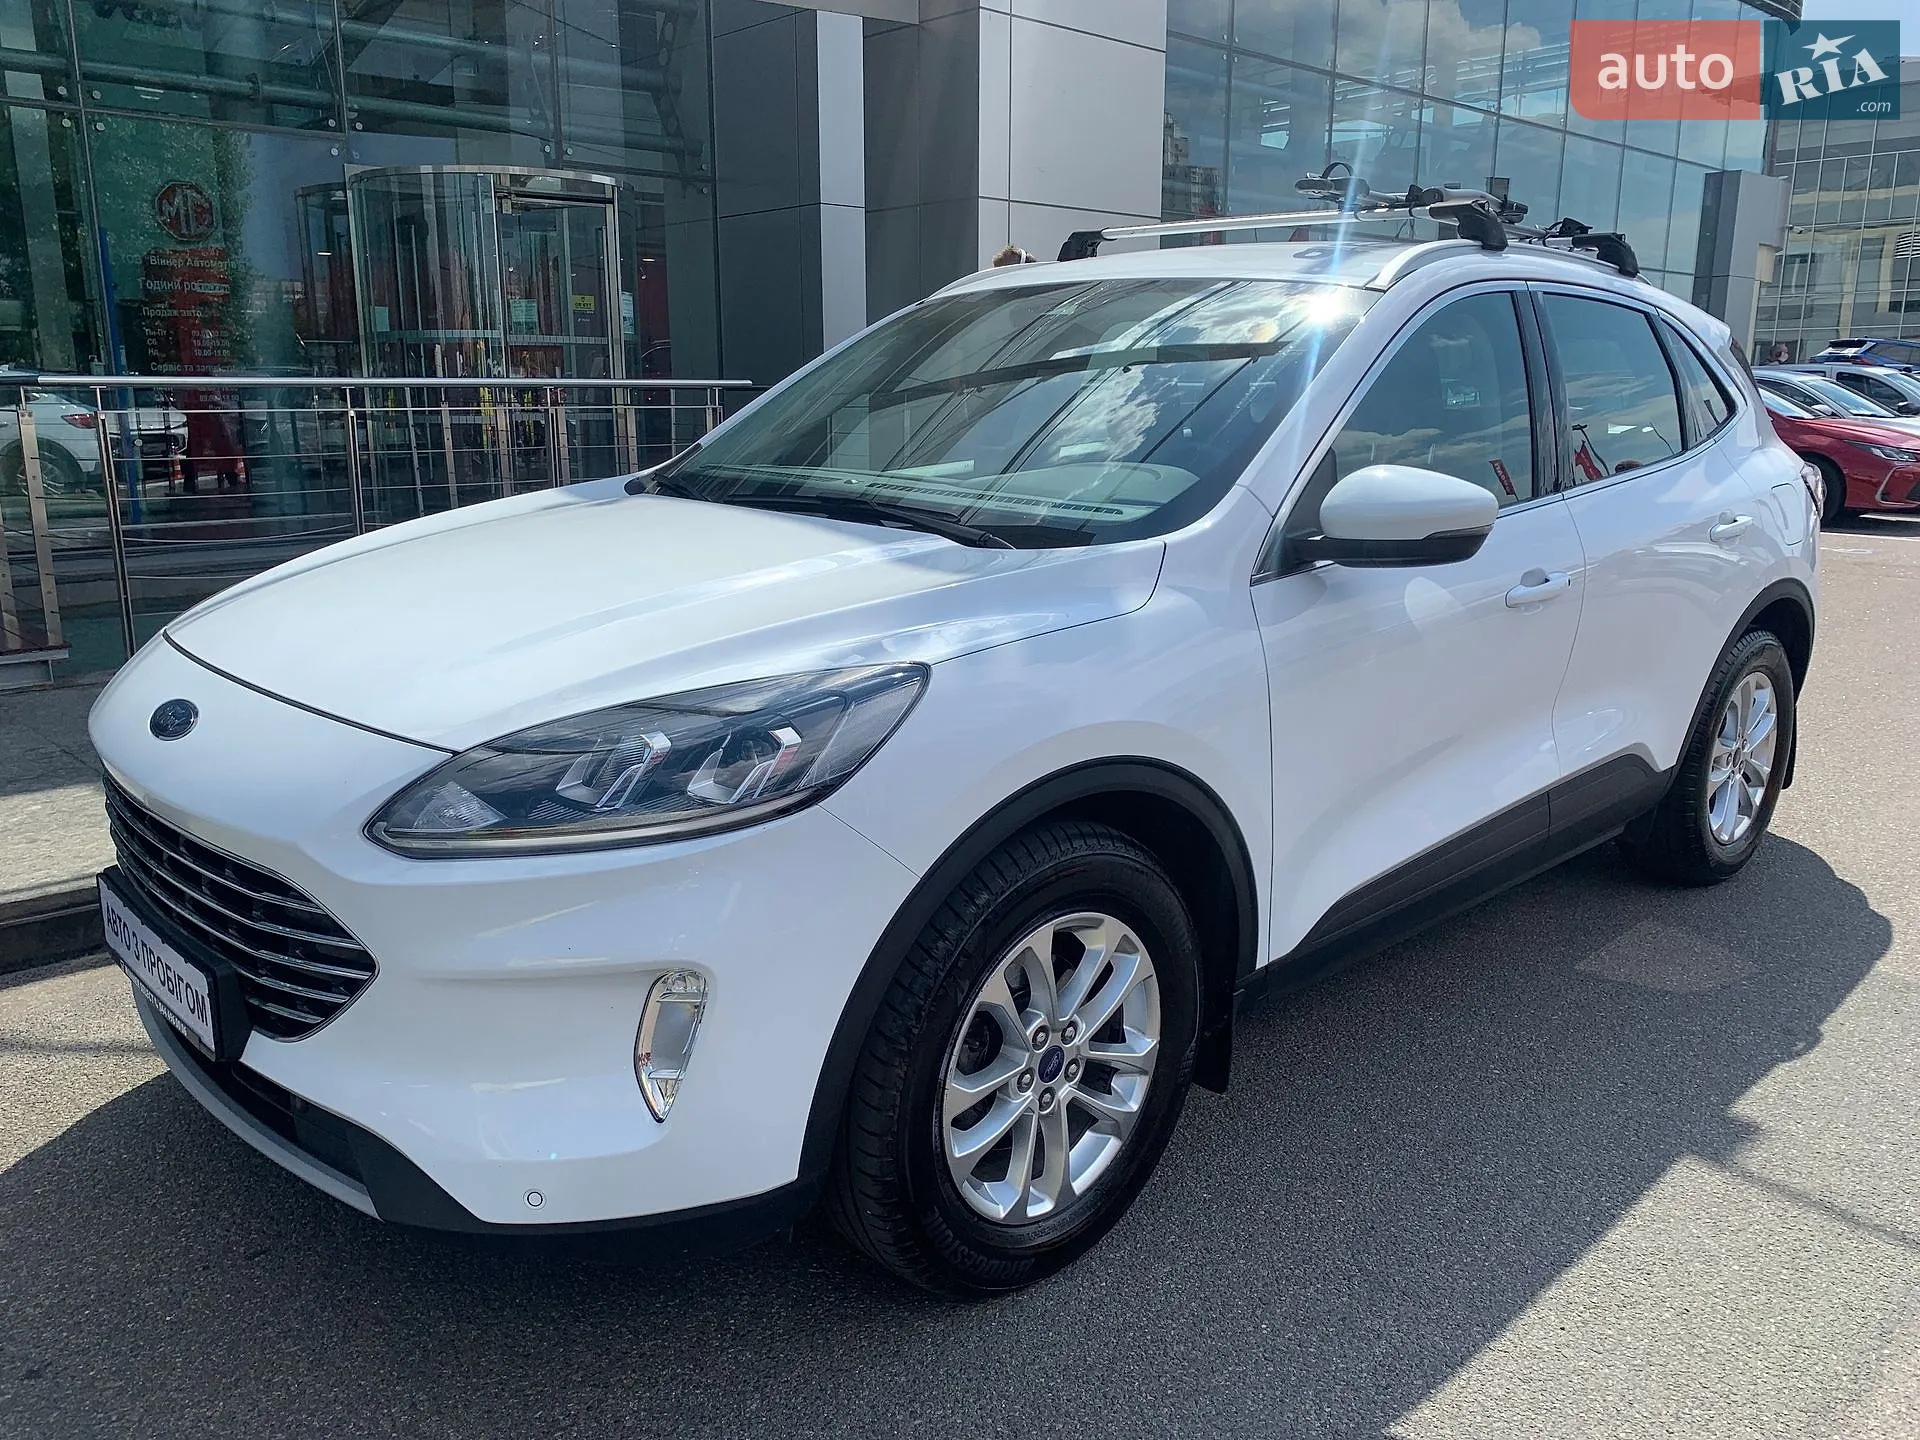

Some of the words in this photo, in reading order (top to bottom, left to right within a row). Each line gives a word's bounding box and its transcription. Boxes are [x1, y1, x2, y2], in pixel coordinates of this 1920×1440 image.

[162, 186, 212, 233] MG
[142, 306, 180, 318] Продаж
[106, 902, 131, 951] АВТО
[141, 940, 209, 1026] ПРОБІГОМ
